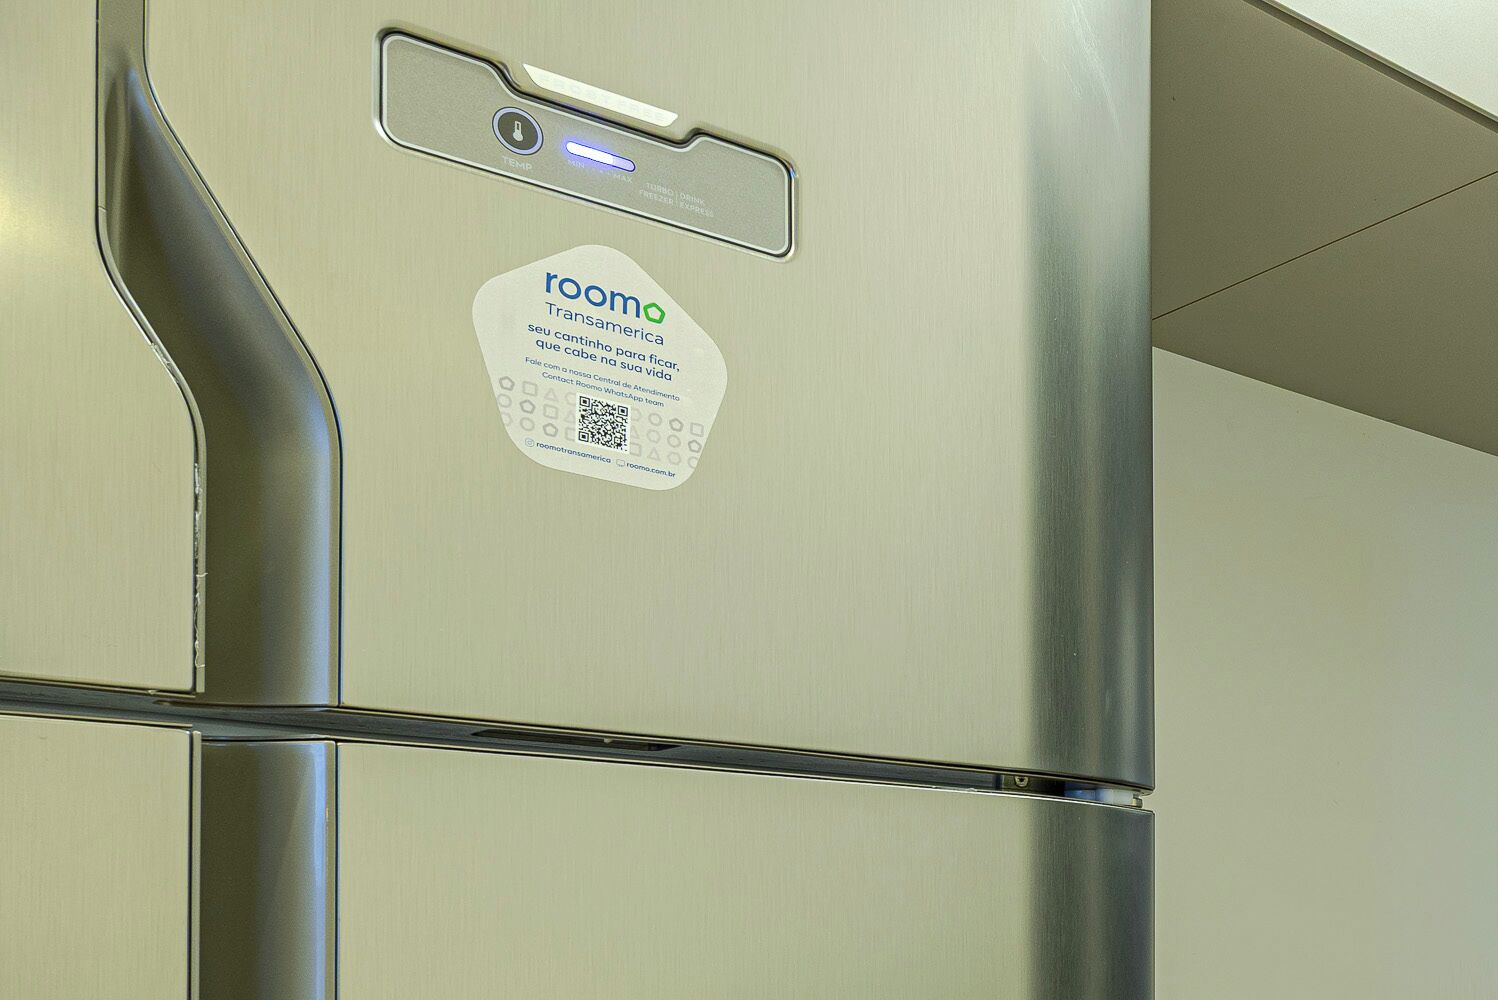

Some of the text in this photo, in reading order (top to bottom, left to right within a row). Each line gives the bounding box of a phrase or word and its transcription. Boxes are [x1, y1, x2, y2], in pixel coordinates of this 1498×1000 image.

[502, 155, 532, 171] TEMP
[567, 159, 633, 184] MIN MAX
[639, 190, 714, 218] FREEZER EXPRESS
[646, 183, 705, 205] TURBO DRINK
[546, 302, 664, 345] Transamerica
[528, 325, 680, 372] seu cantinho para ficar,
[536, 340, 672, 381] que cabe na sua vida
[525, 357, 541, 367] Fale
[544, 362, 561, 371] com
[569, 369, 591, 379] nossa
[593, 373, 620, 386] Central
[622, 379, 632, 389] de
[634, 384, 680, 402] Atendimento
[542, 371, 664, 407] Contact Roomo WhatsApp team
[536, 441, 611, 463] roomotransamerica
[626, 462, 675, 478] roomo.com.br
